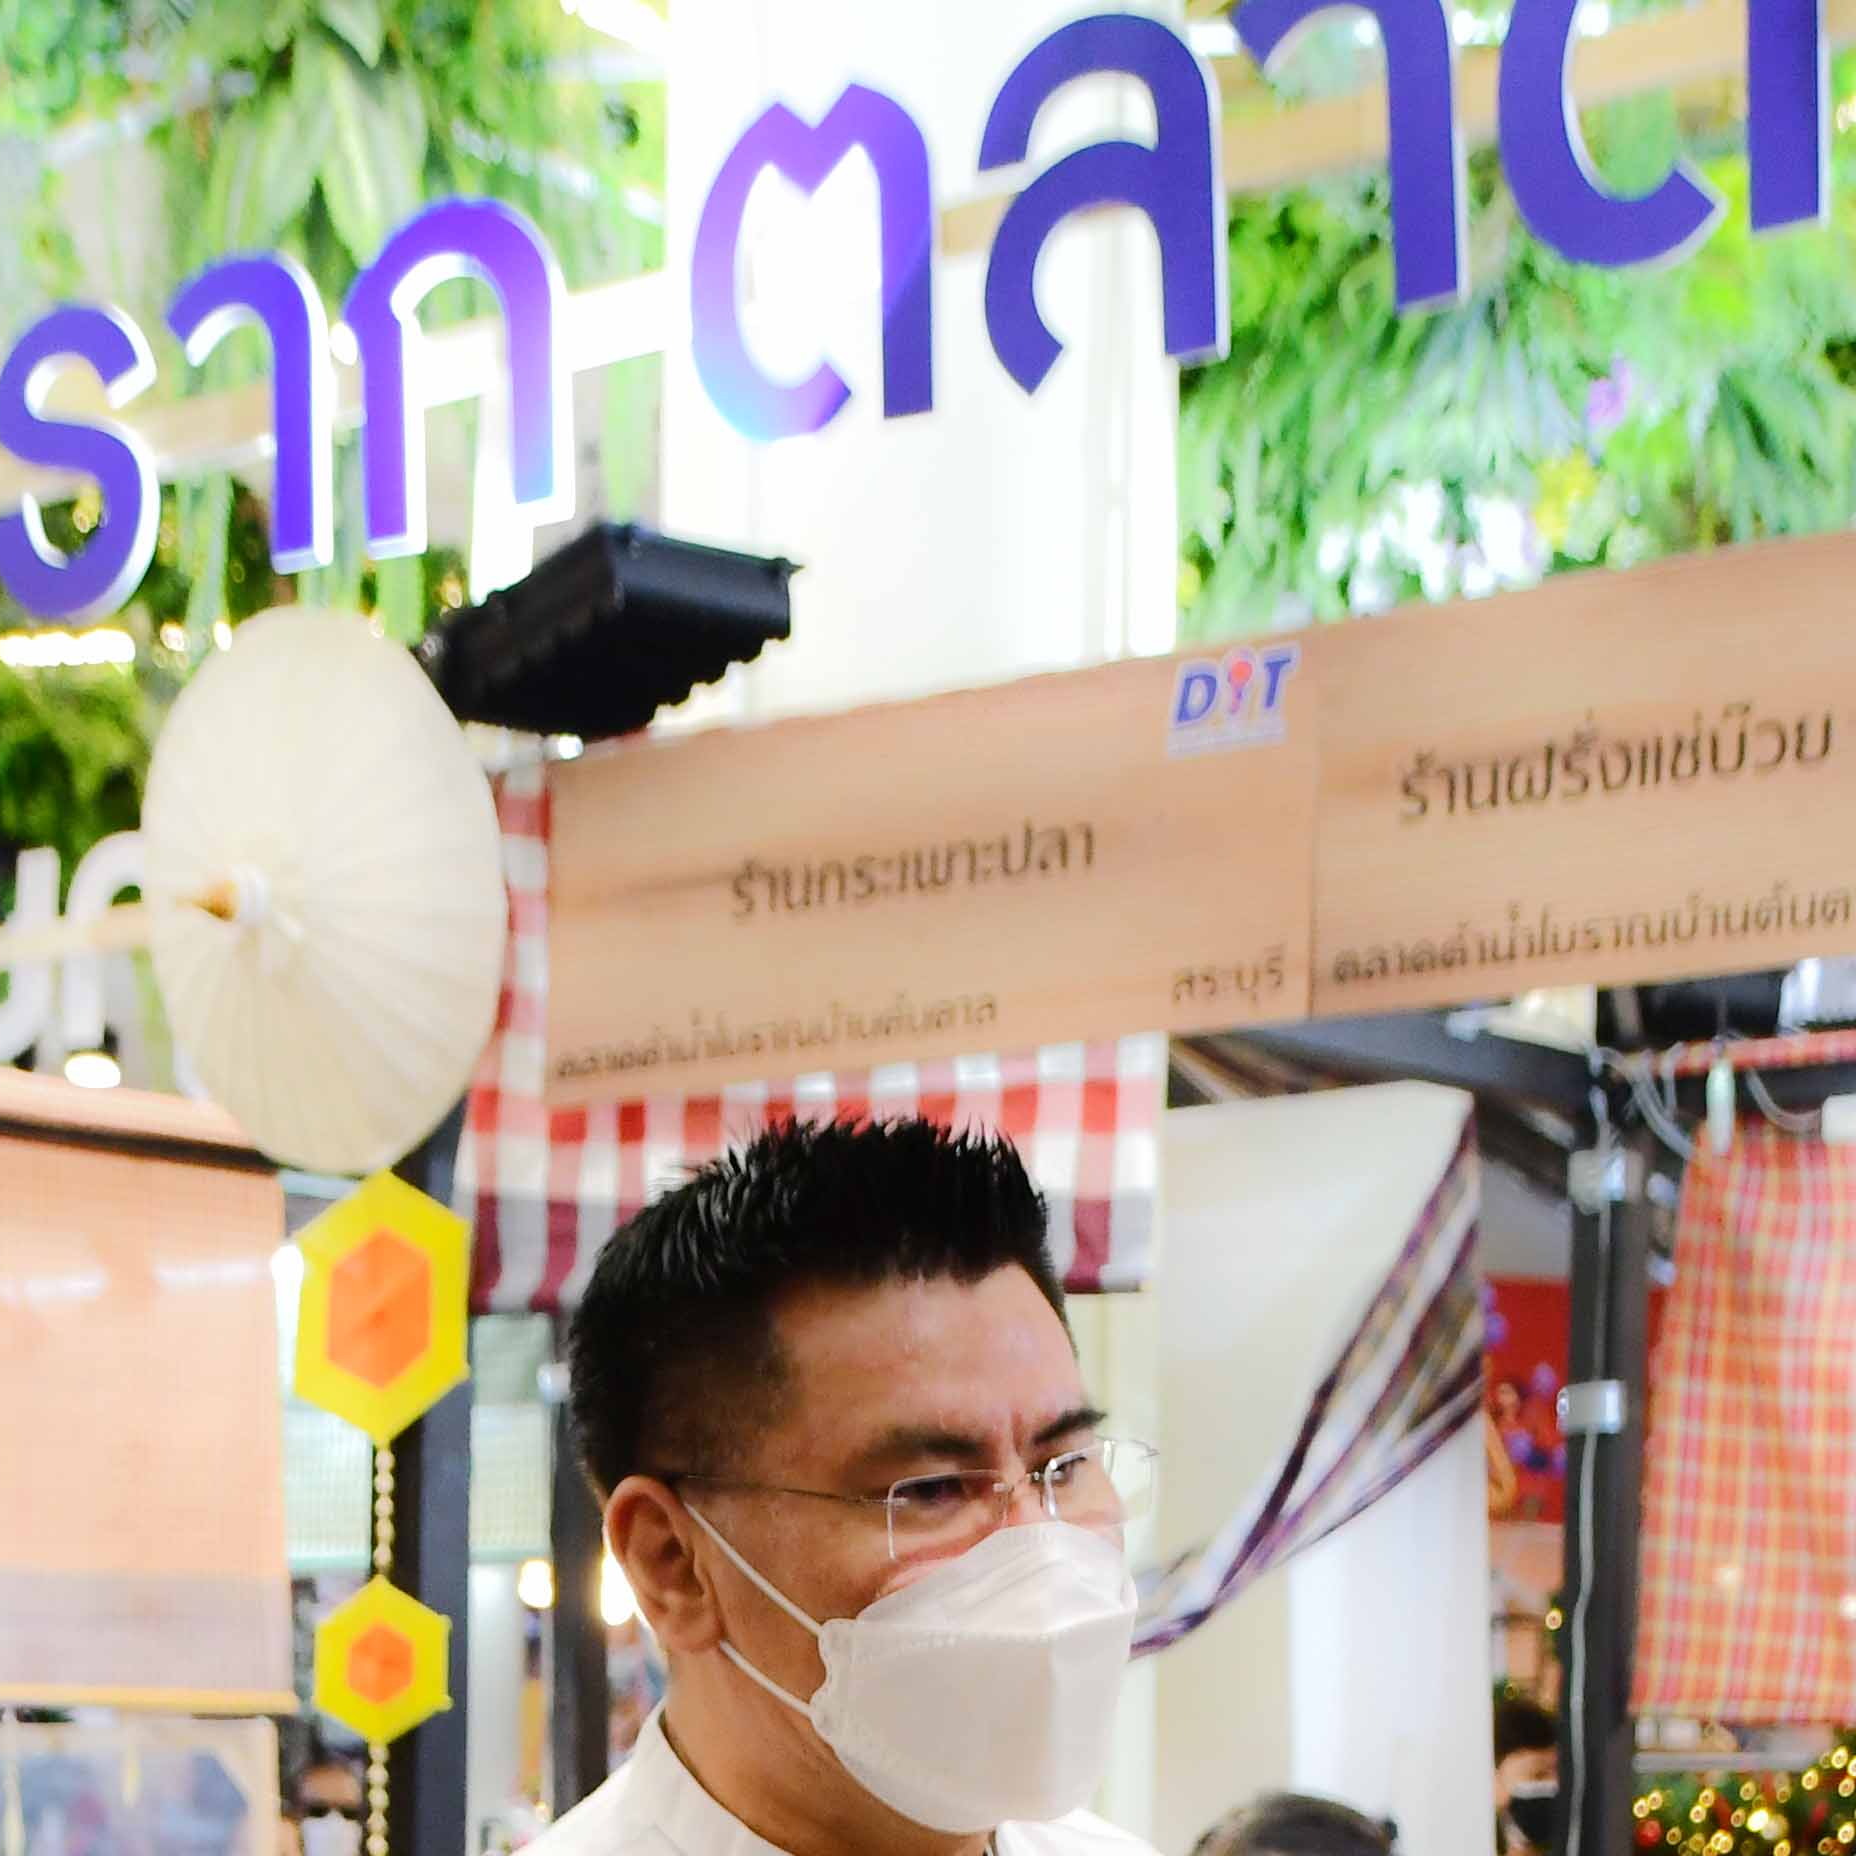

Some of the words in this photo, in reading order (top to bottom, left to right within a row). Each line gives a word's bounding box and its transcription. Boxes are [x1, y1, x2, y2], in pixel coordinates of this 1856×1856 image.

[729, 818, 1097, 924] ร้านกระเพาะปลา
[1170, 943, 1286, 1008] สระบุรี
